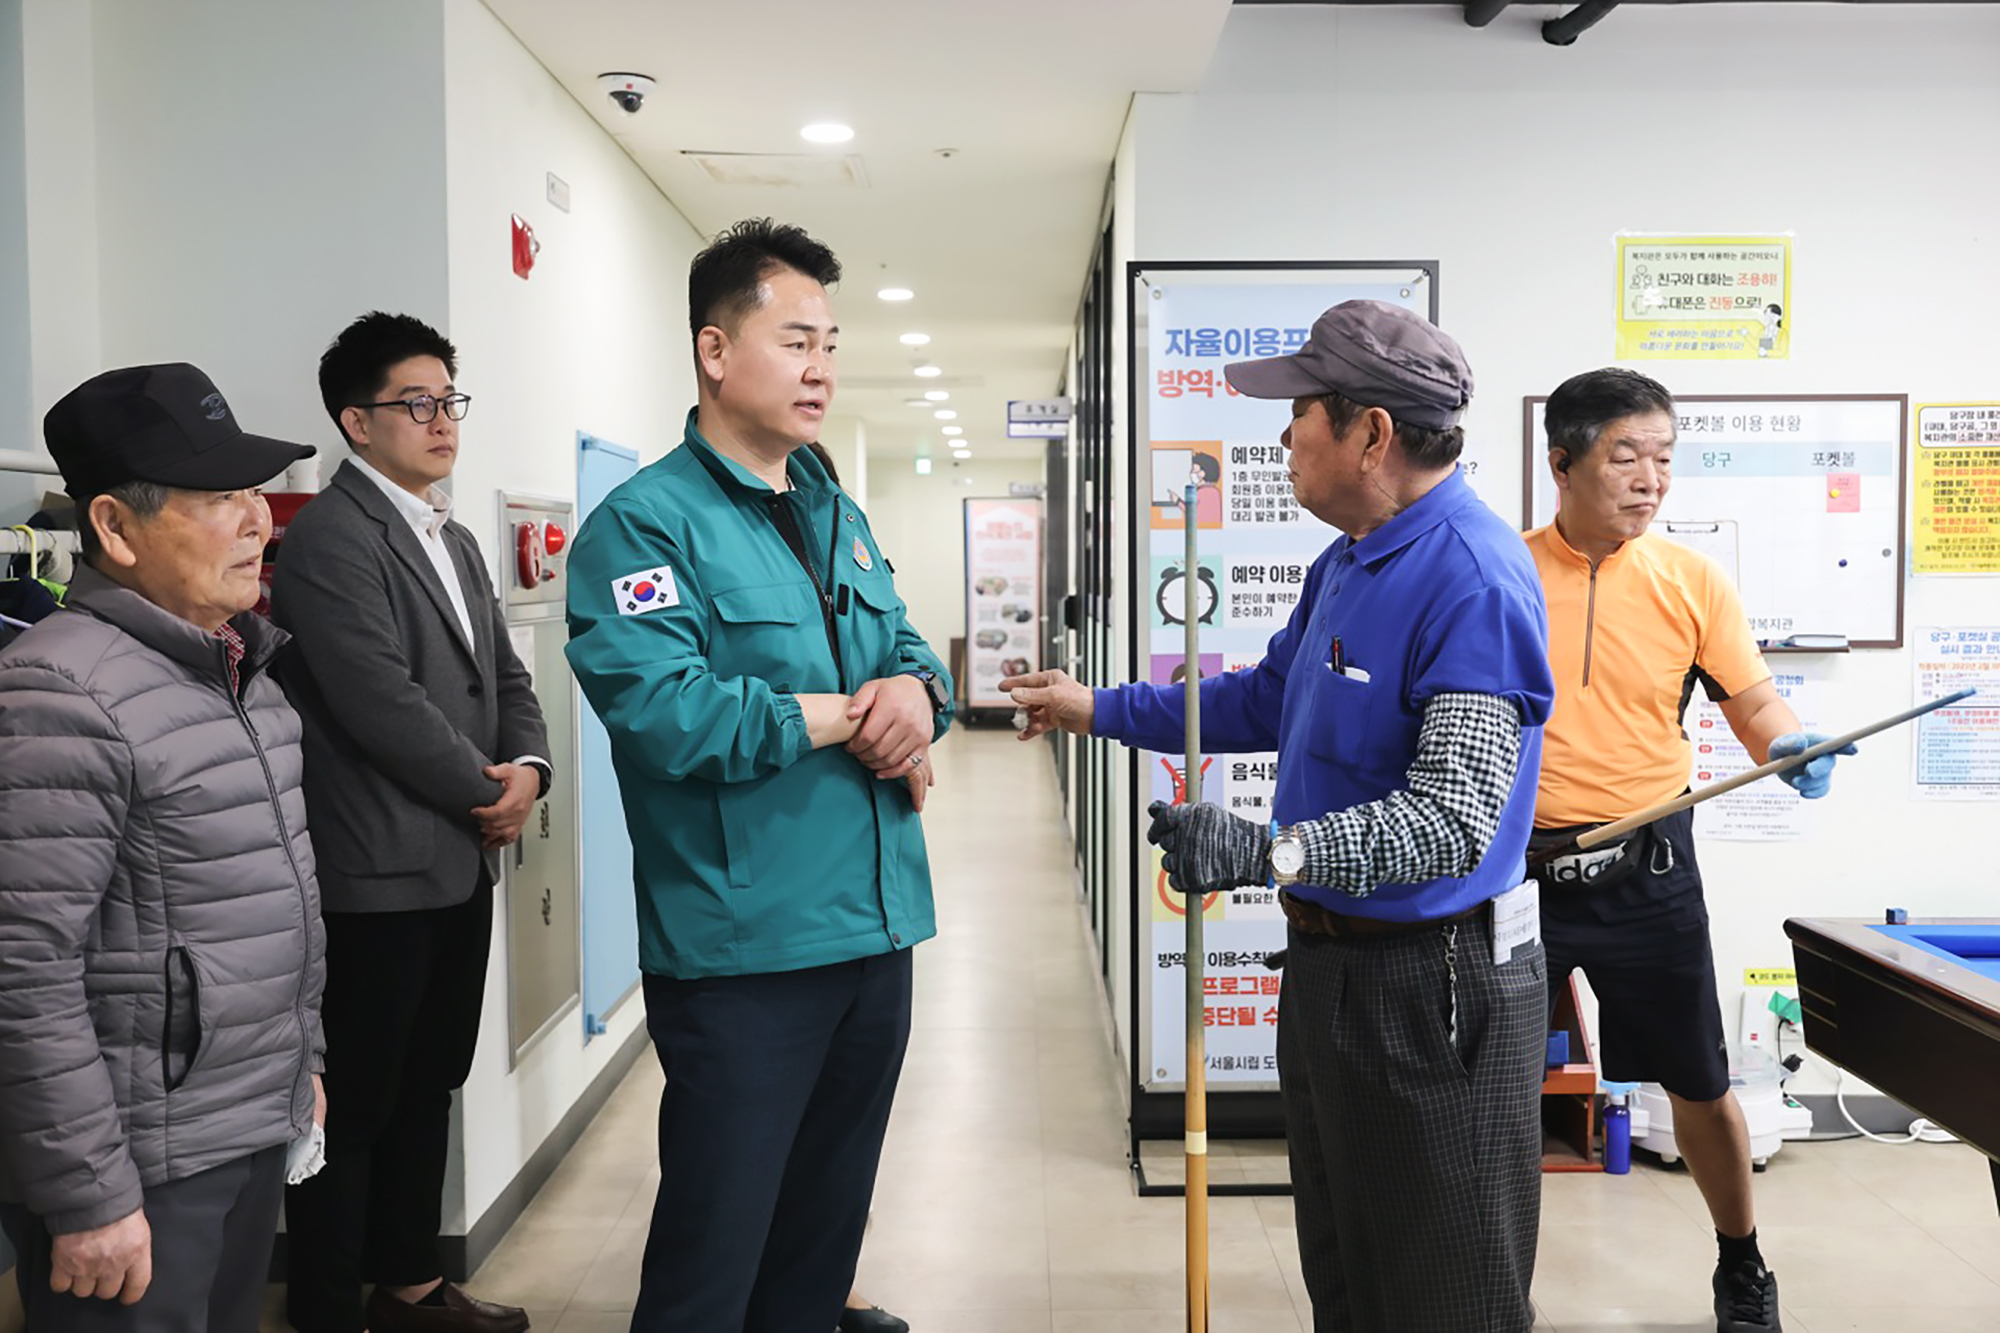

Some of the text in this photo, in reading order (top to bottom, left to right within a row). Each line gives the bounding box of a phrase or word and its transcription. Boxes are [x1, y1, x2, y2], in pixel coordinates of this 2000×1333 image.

[1665, 251, 1687, 261] 모두가
[1708, 251, 1738, 261] 사용하는
[1657, 273, 1693, 287] 친구와
[1697, 272, 1734, 287] 대화는
[1658, 296, 1706, 310] 대폰은
[1157, 369, 1241, 398] 방역·
[1678, 415, 1801, 432] 포켓볼 이용 현황
[1232, 446, 1283, 464] 예약제
[1702, 451, 1732, 469] 당구
[1812, 450, 1857, 468] 포켓볼
[1232, 471, 1247, 482] 1층
[1231, 497, 1251, 509] 당일
[1255, 497, 1275, 509] 이용
[1231, 510, 1252, 522] 대리
[1232, 565, 1265, 584] 예약
[1232, 593, 1298, 604] 본인이 예약한
[1232, 606, 1274, 618] 준수하기
[1776, 688, 1791, 697] 내
[1210, 1056, 1259, 1070] 서울시립
